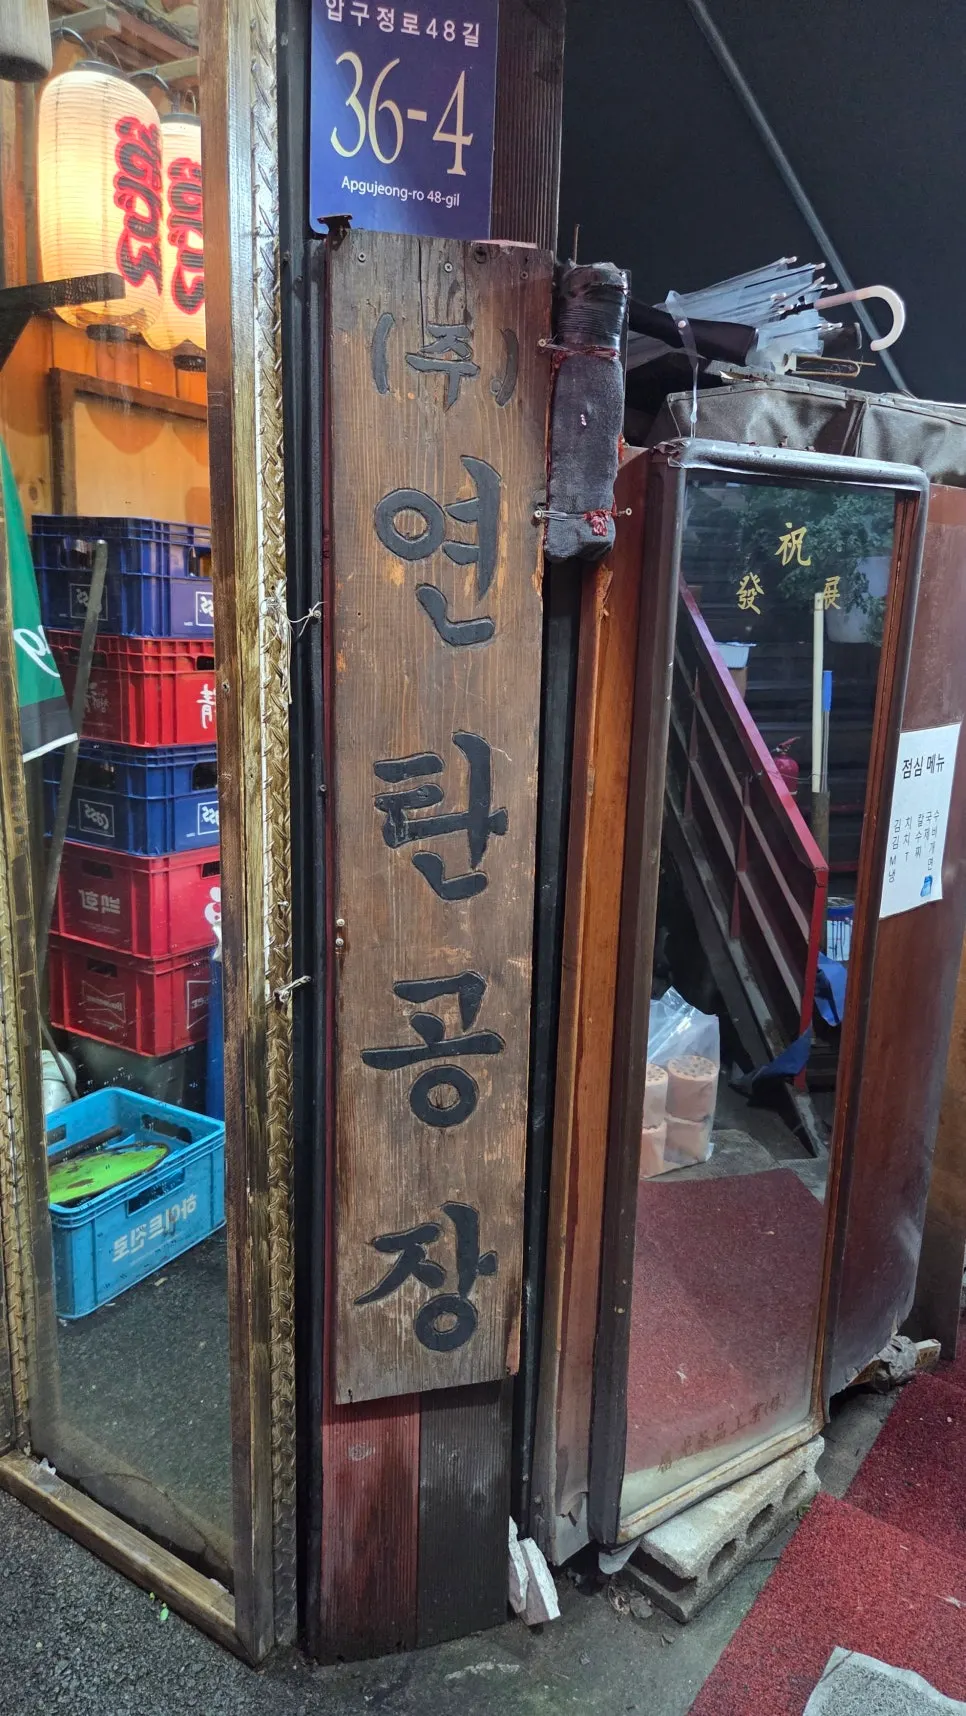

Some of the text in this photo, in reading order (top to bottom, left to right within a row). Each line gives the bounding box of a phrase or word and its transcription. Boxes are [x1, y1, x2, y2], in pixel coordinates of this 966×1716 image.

[325, 0, 481, 47] 압구정로48길
[330, 51, 474, 176] 36-4
[341, 175, 460, 208] Apgujeong-ro 48-gil
[774, 521, 811, 567] 祝
[902, 753, 945, 780] 점심 메뉴
